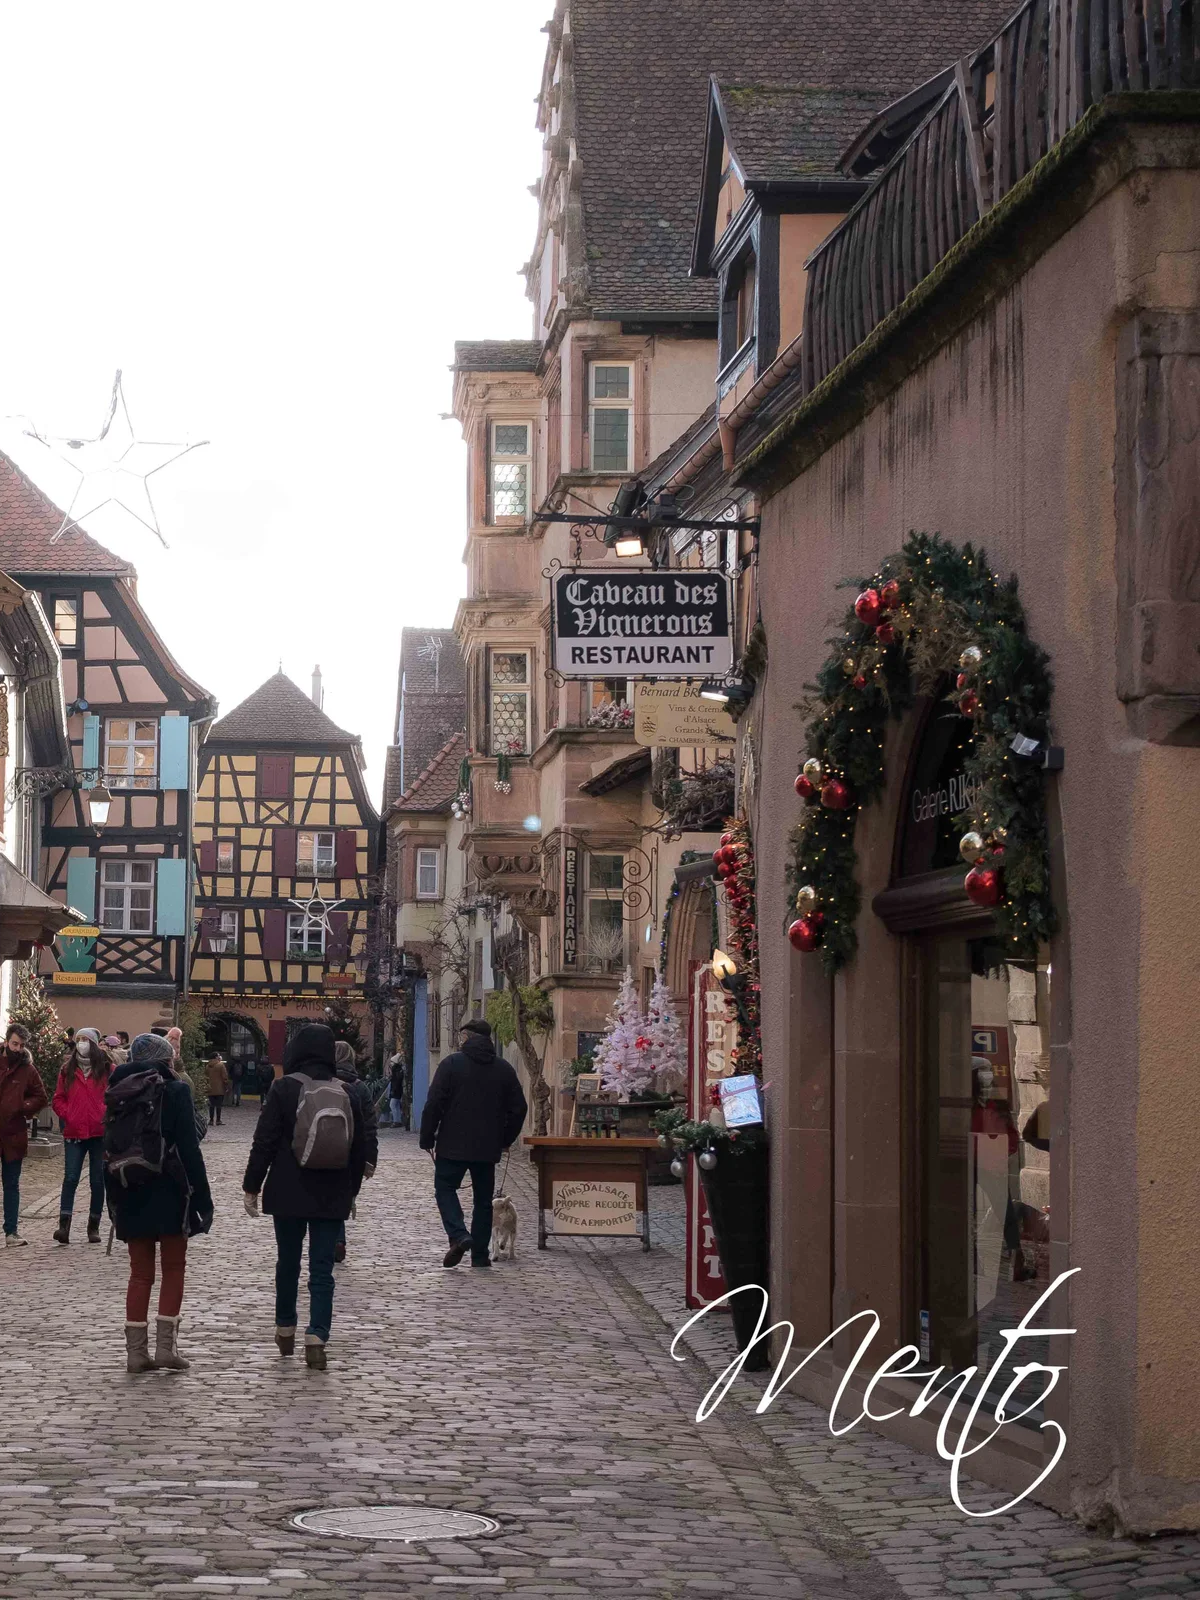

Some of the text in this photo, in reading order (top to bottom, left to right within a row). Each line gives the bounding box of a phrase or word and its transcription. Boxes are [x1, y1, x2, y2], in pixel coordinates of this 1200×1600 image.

[566, 578, 718, 606] Caveau des
[572, 608, 713, 638] Vignerons
[571, 645, 714, 664] RESTAURANT
[640, 686, 680, 697] Bernard
[668, 704, 725, 713] Vins & Créma
[684, 715, 716, 724] d'Alsace
[675, 725, 704, 734] Grands
[912, 783, 948, 823] Galerie
[565, 850, 576, 962] RESTAURANT
[56, 973, 93, 983] Restaurant
[205, 998, 279, 1010] BOULANGERIE
[557, 1183, 630, 1201] VINS D'ALSACE
[556, 1200, 634, 1209] PROPRE RECOLTE
[553, 1207, 580, 1225] VENTE
[588, 1212, 636, 1227] EMPORTER
